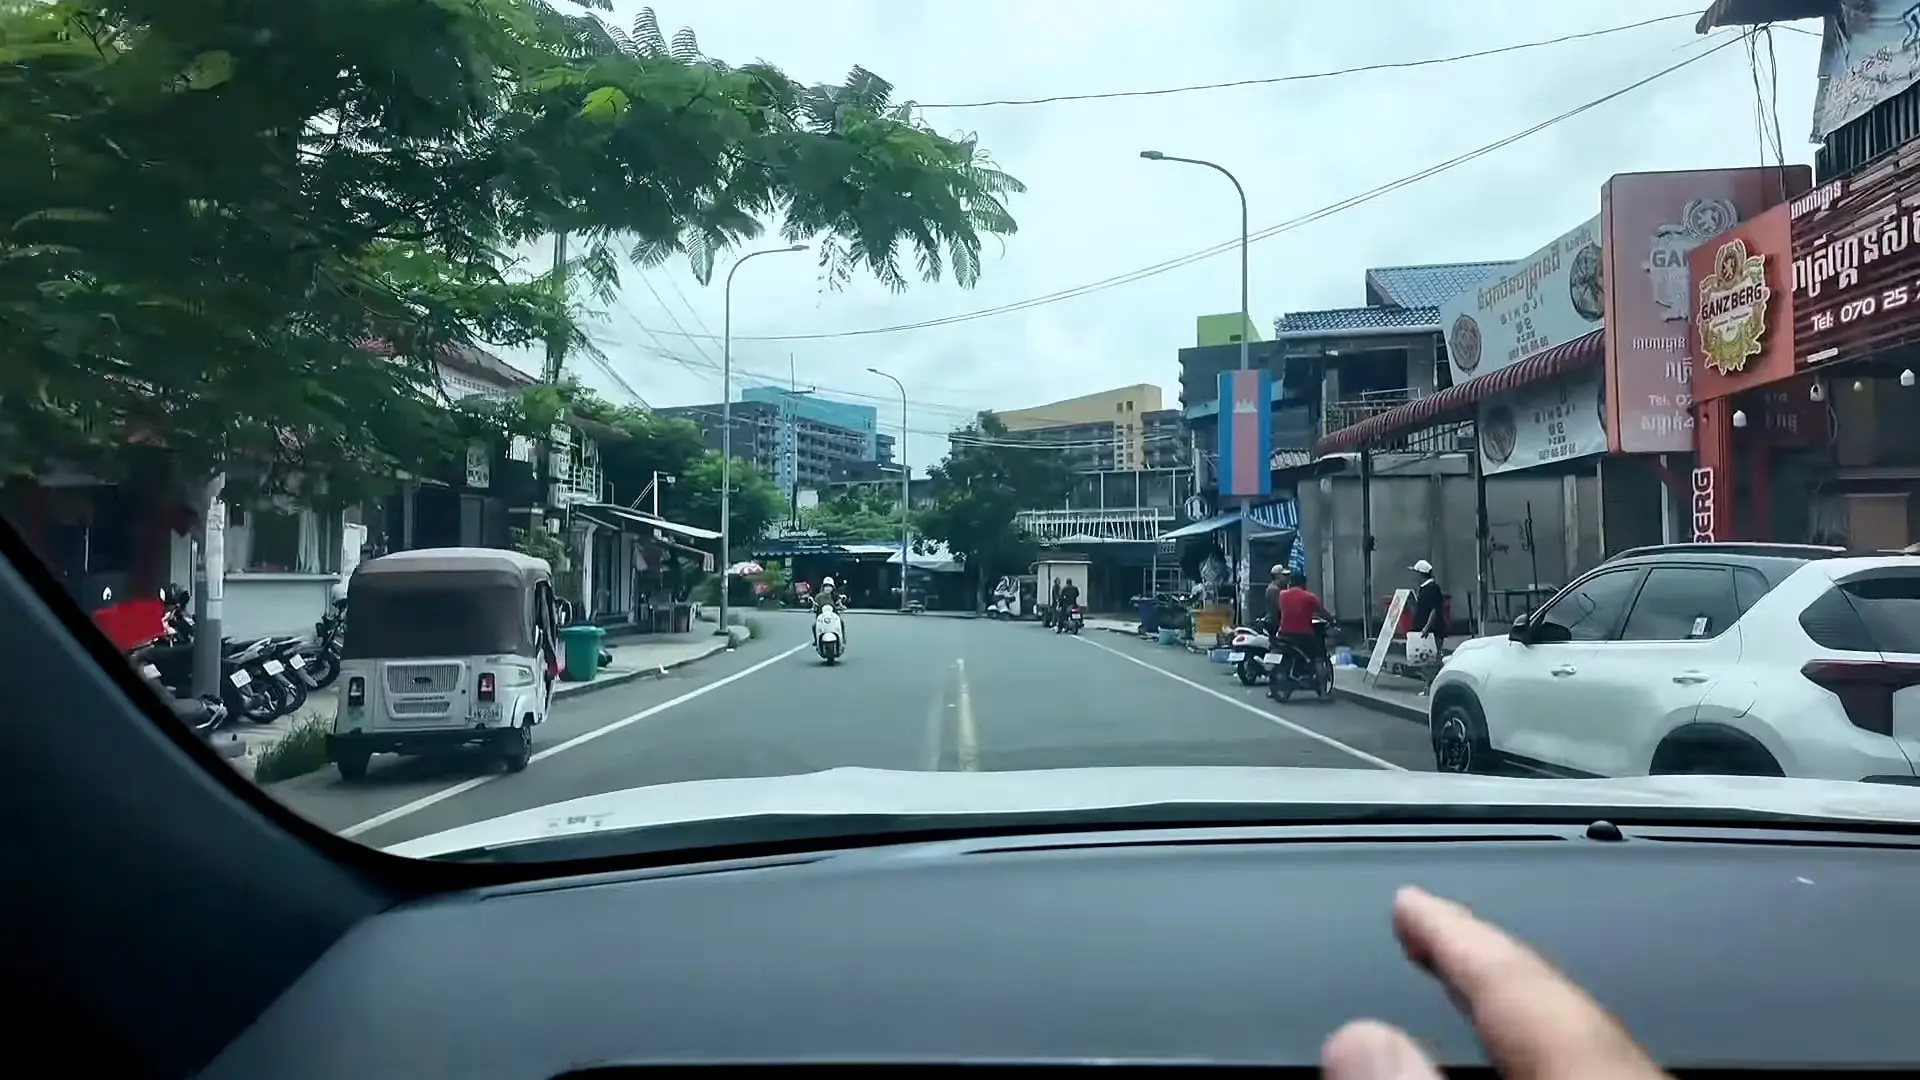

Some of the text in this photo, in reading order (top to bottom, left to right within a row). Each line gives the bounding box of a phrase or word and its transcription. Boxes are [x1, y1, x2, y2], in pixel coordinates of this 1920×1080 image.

[1701, 282, 1762, 320] GANZBERG
[1810, 309, 1834, 332] Tel:
[1840, 297, 1875, 323] 070
[1882, 286, 1908, 311] 25
